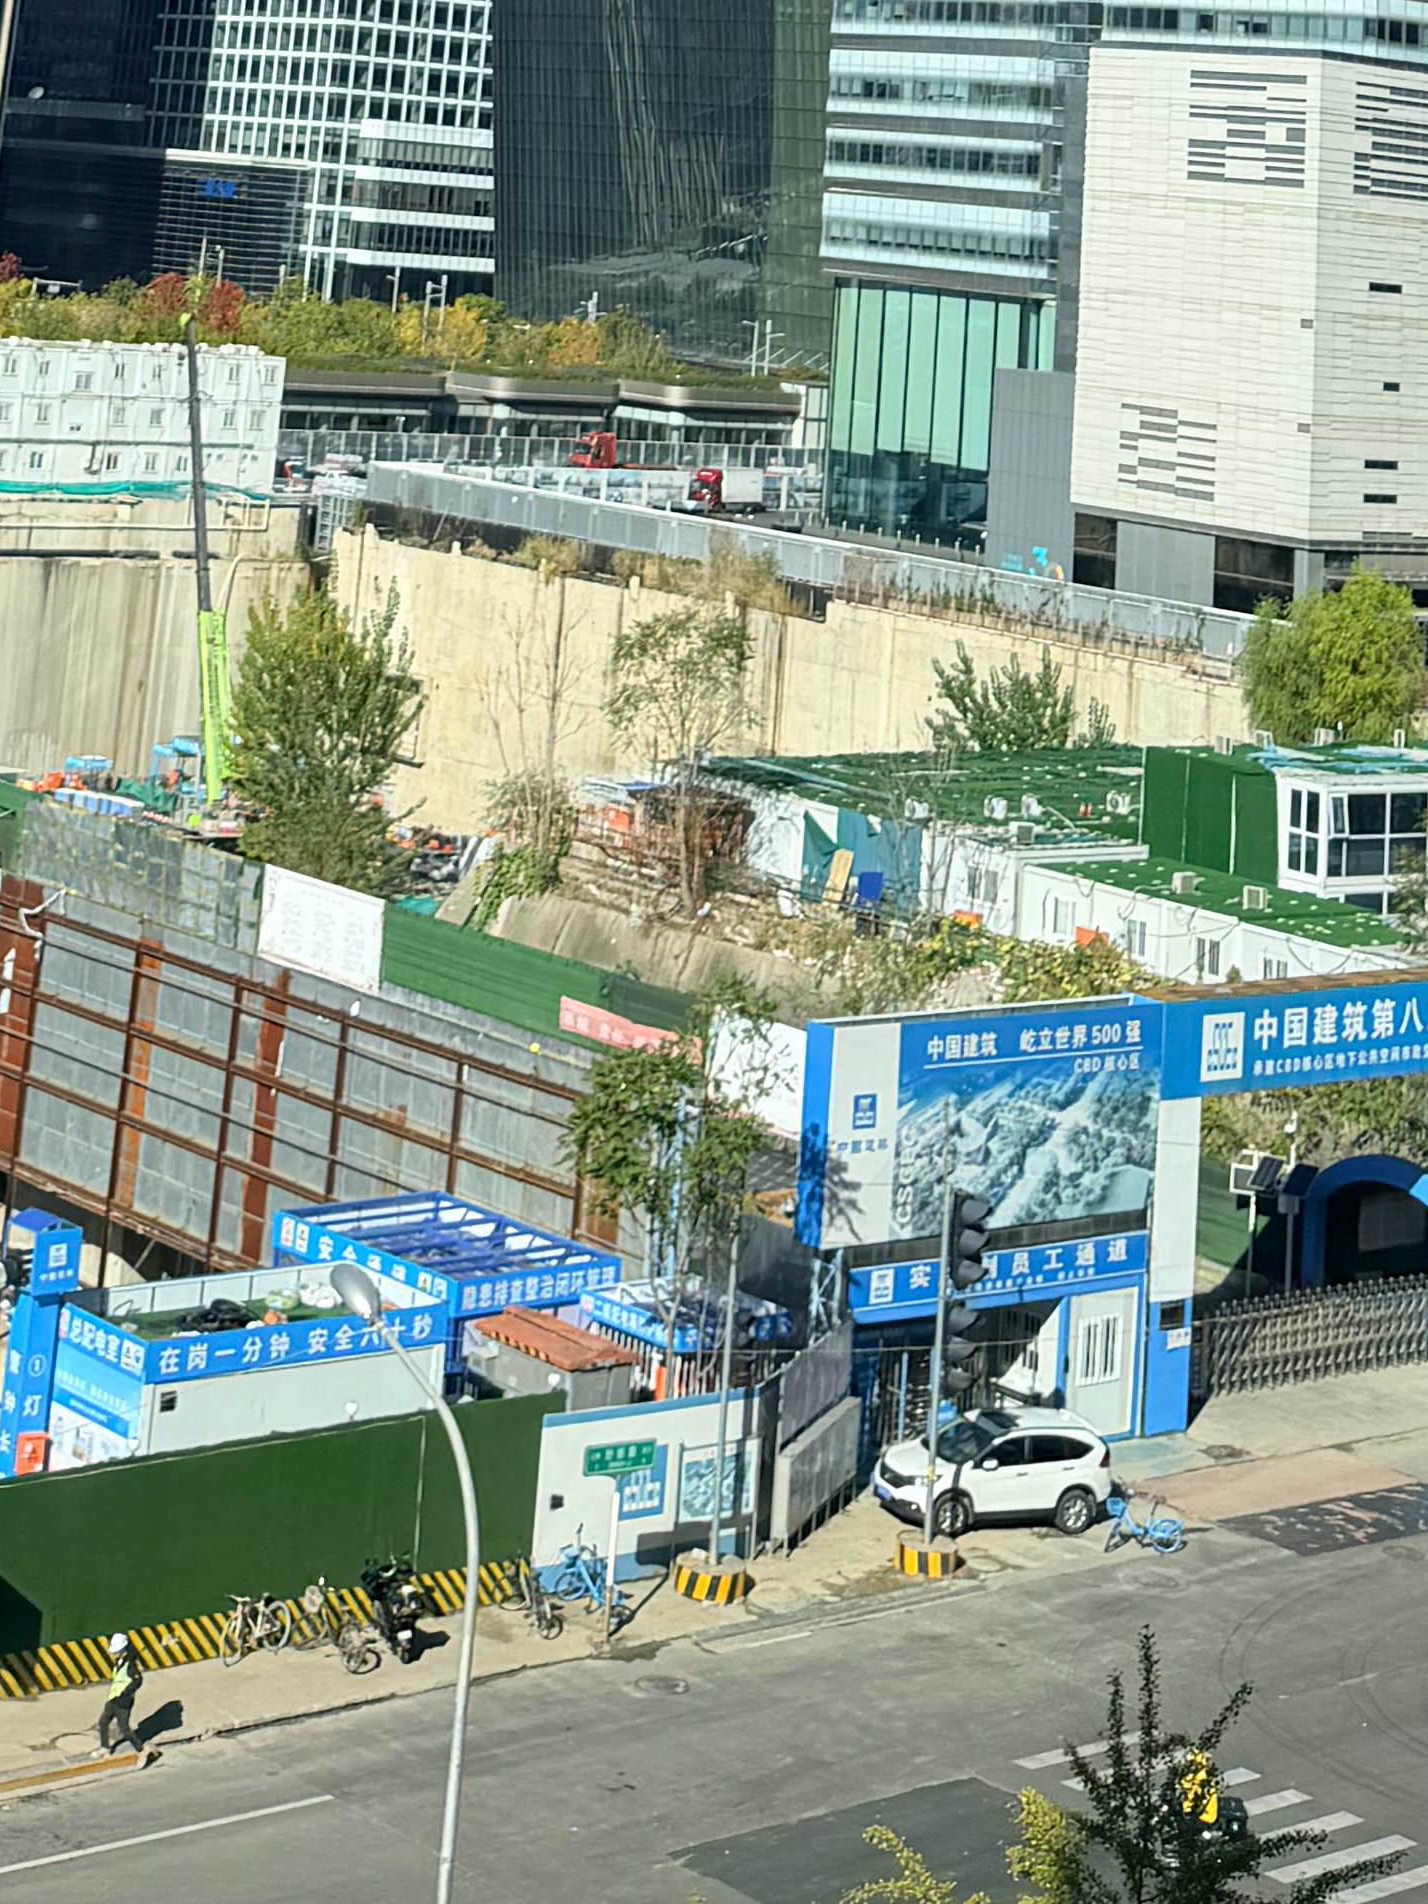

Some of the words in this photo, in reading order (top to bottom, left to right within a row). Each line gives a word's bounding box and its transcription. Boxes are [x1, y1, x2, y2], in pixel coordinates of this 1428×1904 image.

[927, 1032, 997, 1061] 中国建筑
[1019, 1024, 1088, 1053] 屹立世界
[1091, 1023, 1121, 1045] 500
[1125, 1020, 1141, 1043] 强
[1074, 1056, 1101, 1073] CBD
[69, 1315, 120, 1363] 总配电室
[159, 1332, 289, 1375] 在岗一分钟
